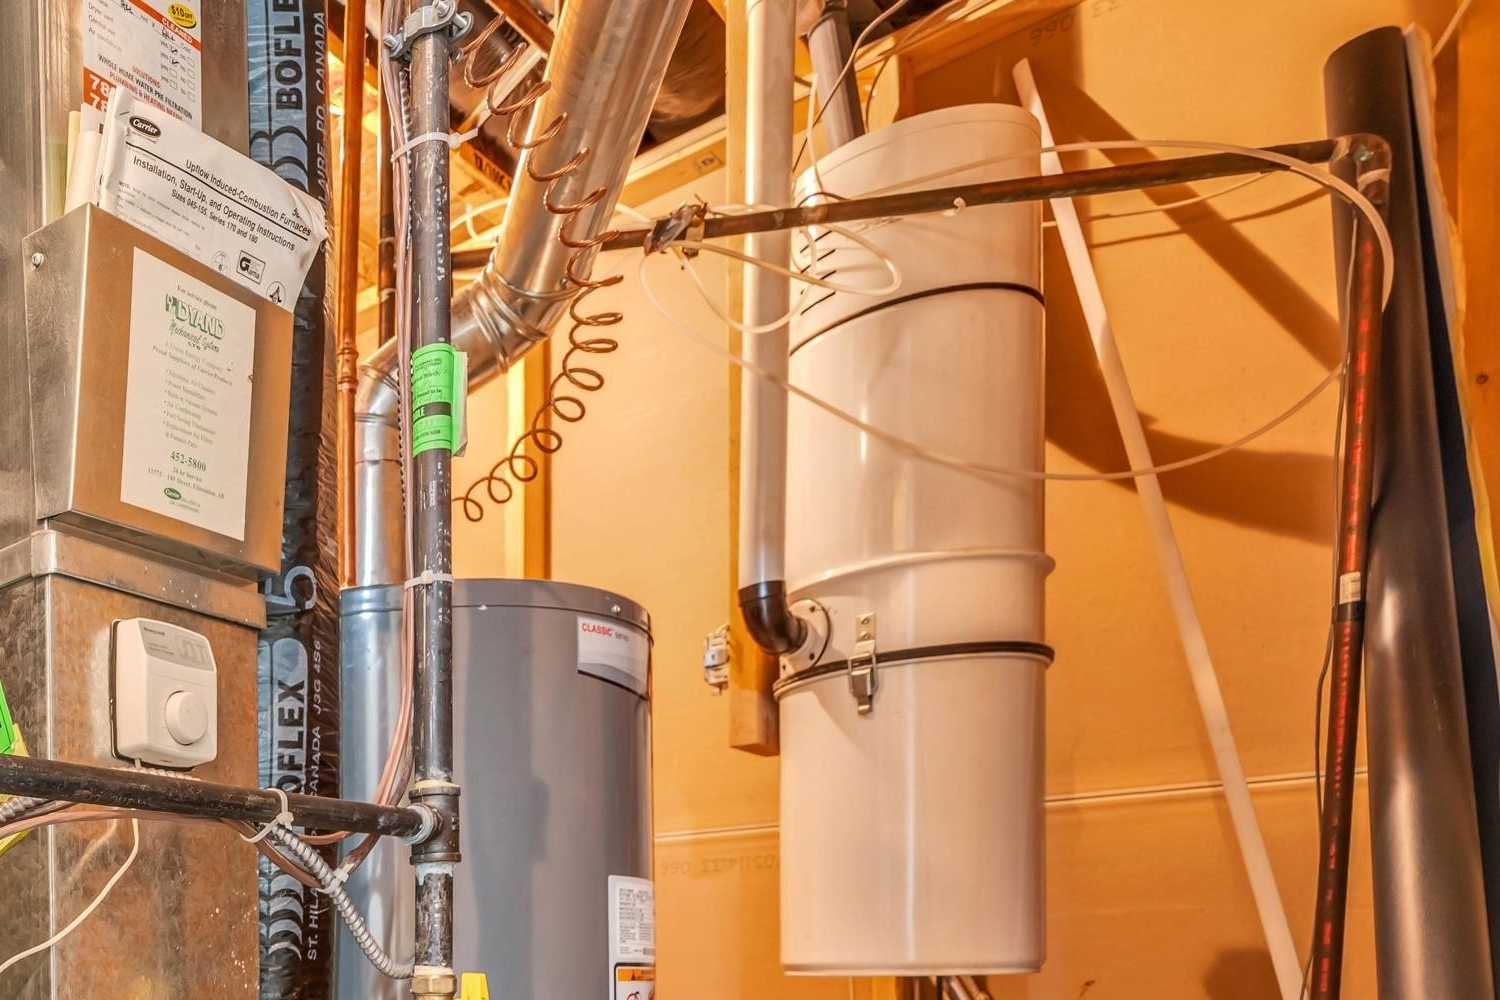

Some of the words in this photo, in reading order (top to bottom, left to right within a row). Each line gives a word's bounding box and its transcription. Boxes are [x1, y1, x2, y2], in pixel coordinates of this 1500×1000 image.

[162, 18, 193, 43] CLEANED
[135, 76, 153, 95] WATER
[131, 116, 160, 137] Carrier
[133, 155, 179, 187] Installation,
[179, 179, 209, 204] Start-Up,
[209, 198, 222, 211] and
[222, 205, 256, 231] Operating
[257, 225, 296, 251] Instructions
[185, 159, 210, 181] Upflow
[209, 173, 280, 220] Induced-Combustion
[280, 212, 312, 237] Furnaces
[171, 189, 187, 203] Sizes
[209, 211, 226, 226] Series
[237, 227, 248, 238] and
[169, 448, 207, 473] 452-5800
[581, 623, 612, 637] CLASSIC
[277, 679, 305, 795] OFLEX
